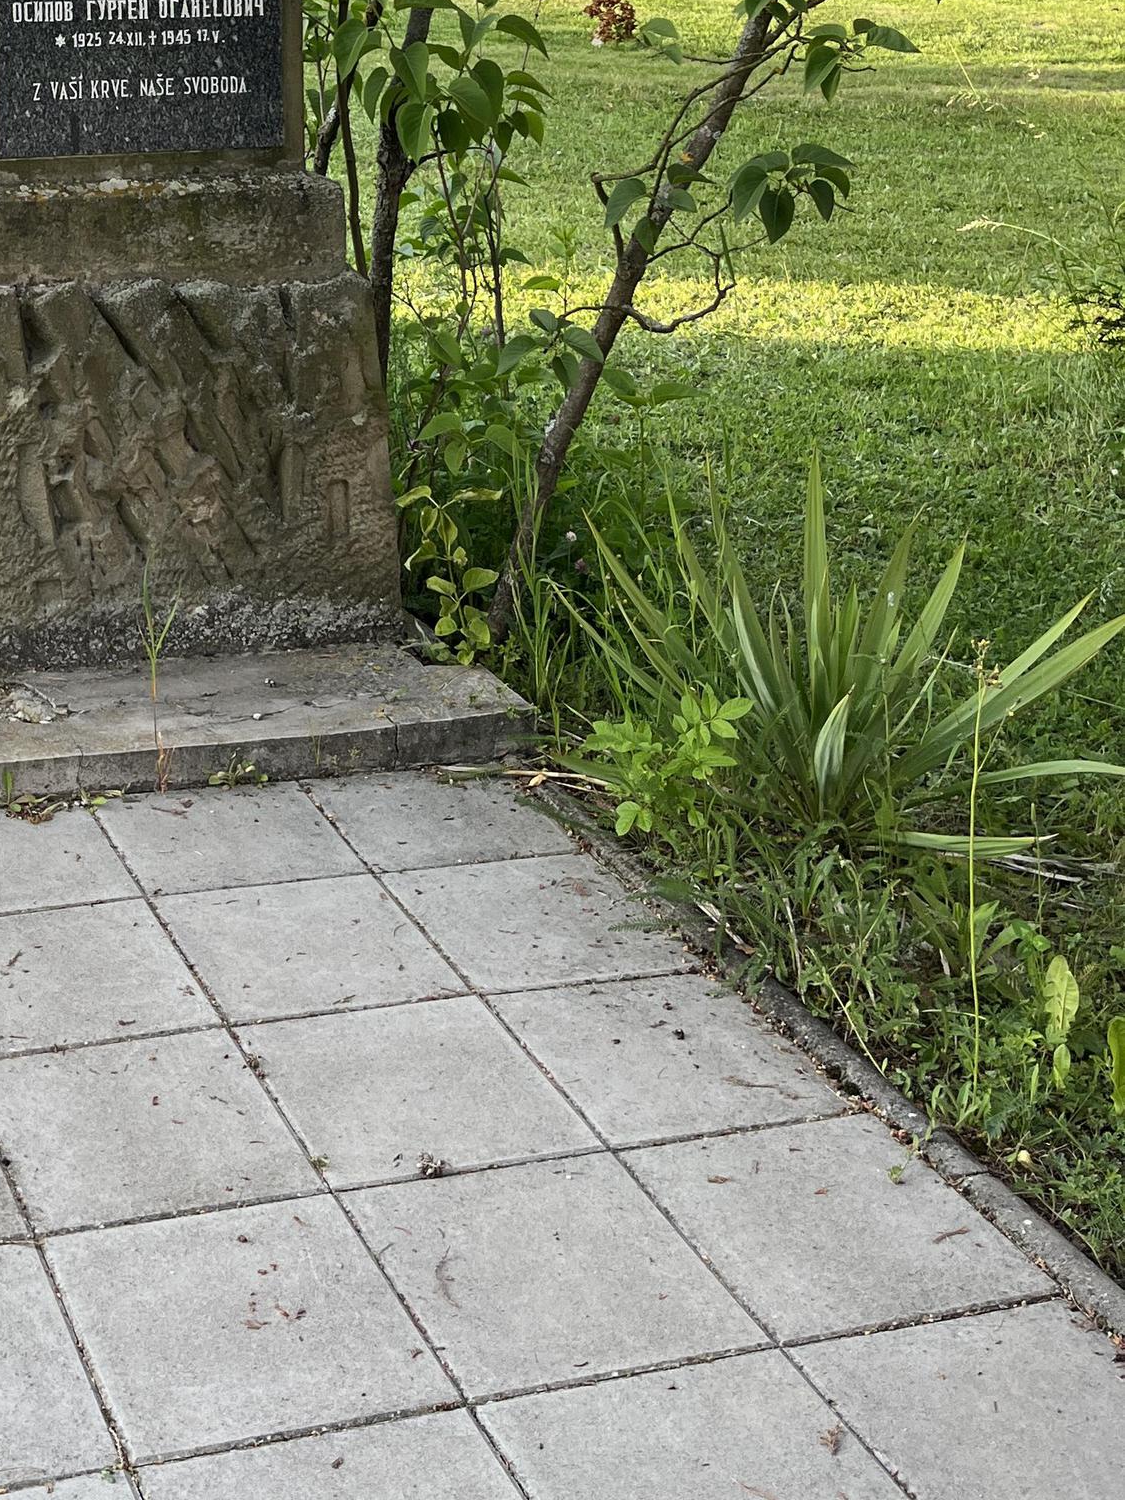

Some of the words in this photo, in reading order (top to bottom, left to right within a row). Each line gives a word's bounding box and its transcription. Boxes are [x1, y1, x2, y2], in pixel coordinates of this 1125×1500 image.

[12, 1, 74, 23] ОСИПОВ
[72, 31, 102, 48] 1925
[161, 29, 191, 46] 1945
[32, 82, 41, 102] Z
[50, 74, 84, 101] VAŠÍ
[139, 73, 175, 97] NAŠE
[183, 75, 252, 95] SVOBODA.
